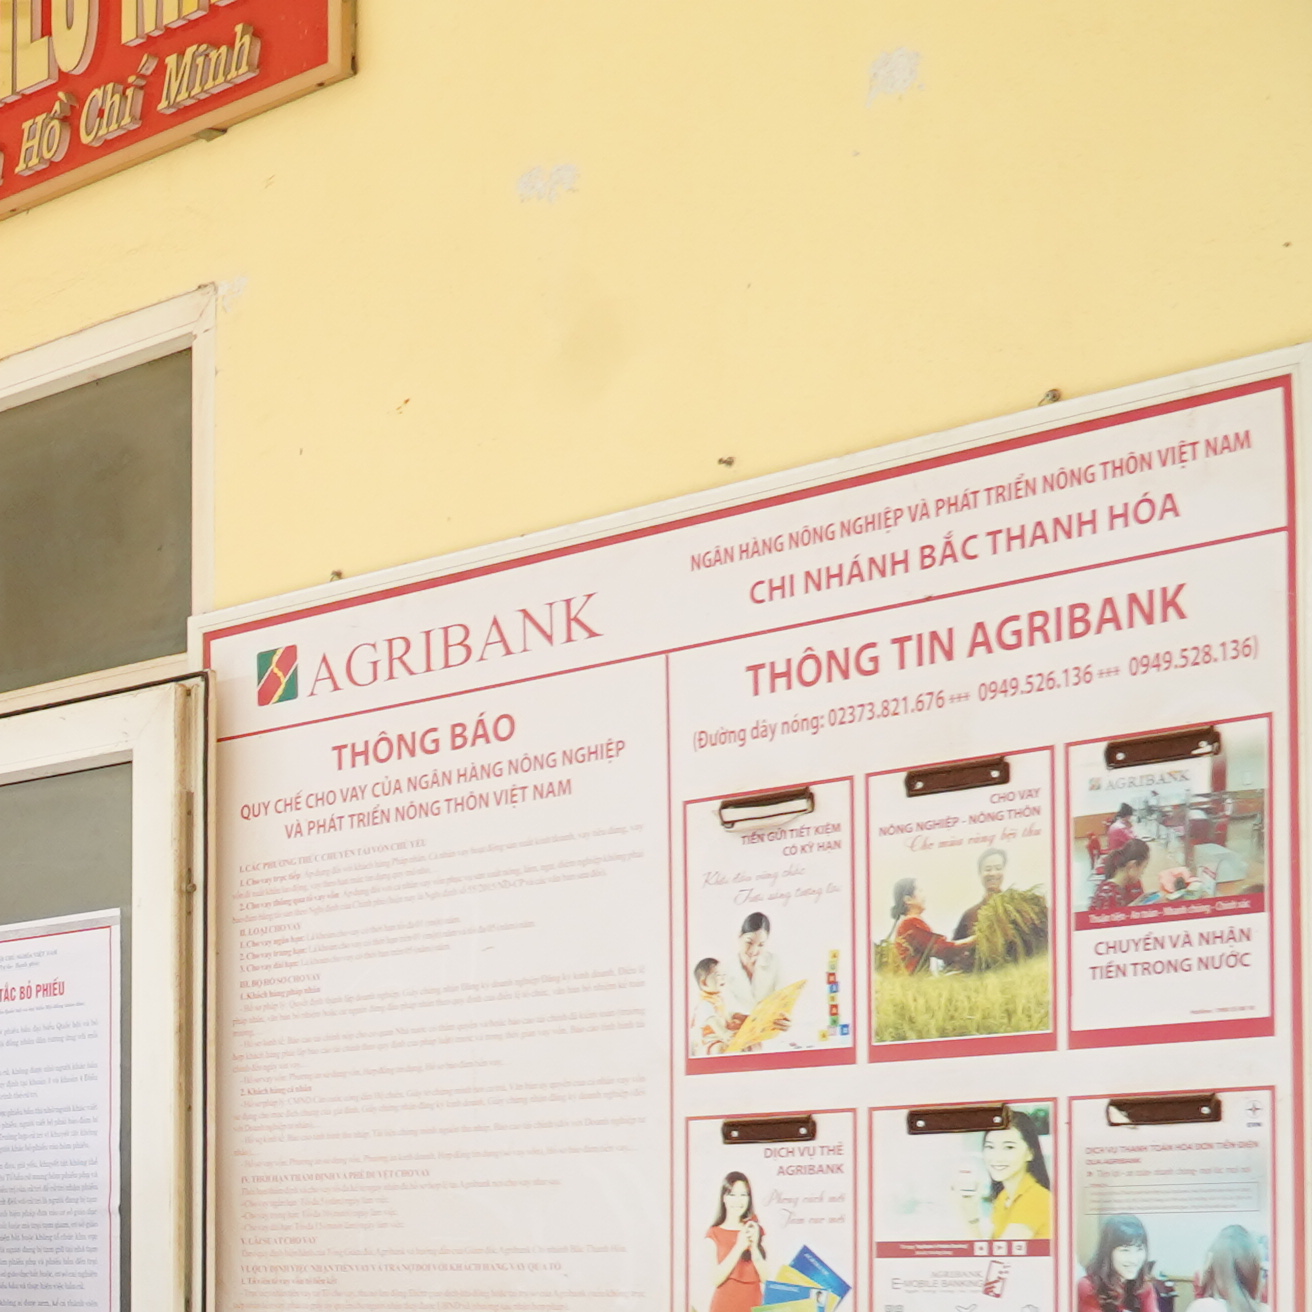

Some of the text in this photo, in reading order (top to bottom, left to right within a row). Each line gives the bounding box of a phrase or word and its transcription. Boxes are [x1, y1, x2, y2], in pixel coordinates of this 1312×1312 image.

[15, 91, 79, 176] Hồ
[79, 53, 160, 147] Chí
[156, 23, 262, 114] Minh
[690, 430, 1252, 571] NGÂN HÀNG NÔNG NGHIỆP VÀ PHÁT TRIỂN NÔNG THÔN VIỆT NAM
[749, 492, 1180, 604] CHI NHÁNH BẮC THANH HÓA
[306, 592, 605, 697] AGRIBANK
[745, 583, 1187, 696] THÔNG TIN AGRIBANK
[751, 720, 778, 742] dây
[781, 713, 825, 734] nóng:
[828, 690, 945, 727] 02373.821.676
[978, 664, 1093, 702] 0949.526.136
[331, 712, 515, 771] THÔNG BÁO
[240, 738, 626, 821] QUY CHẾ CHO VAY CỦA NGÂN HÀNG NÔNG NGHIỆP
[284, 779, 571, 839] VÀ PHÁT TRIỂN NÔNG THÔN VIỆT NAM
[990, 788, 1041, 804] CHO VAY
[878, 804, 1041, 837] NÔNG NGHIỆP NÔNG THÔN
[1089, 951, 1252, 980] TIỀN TRONG NƯỚC
[1094, 927, 1252, 956] CHUYỂN VÀ NHẬN
[19, 980, 32, 1000] BỎ
[35, 977, 65, 998] PHIẾU
[776, 1163, 845, 1176] AGRIBANK
